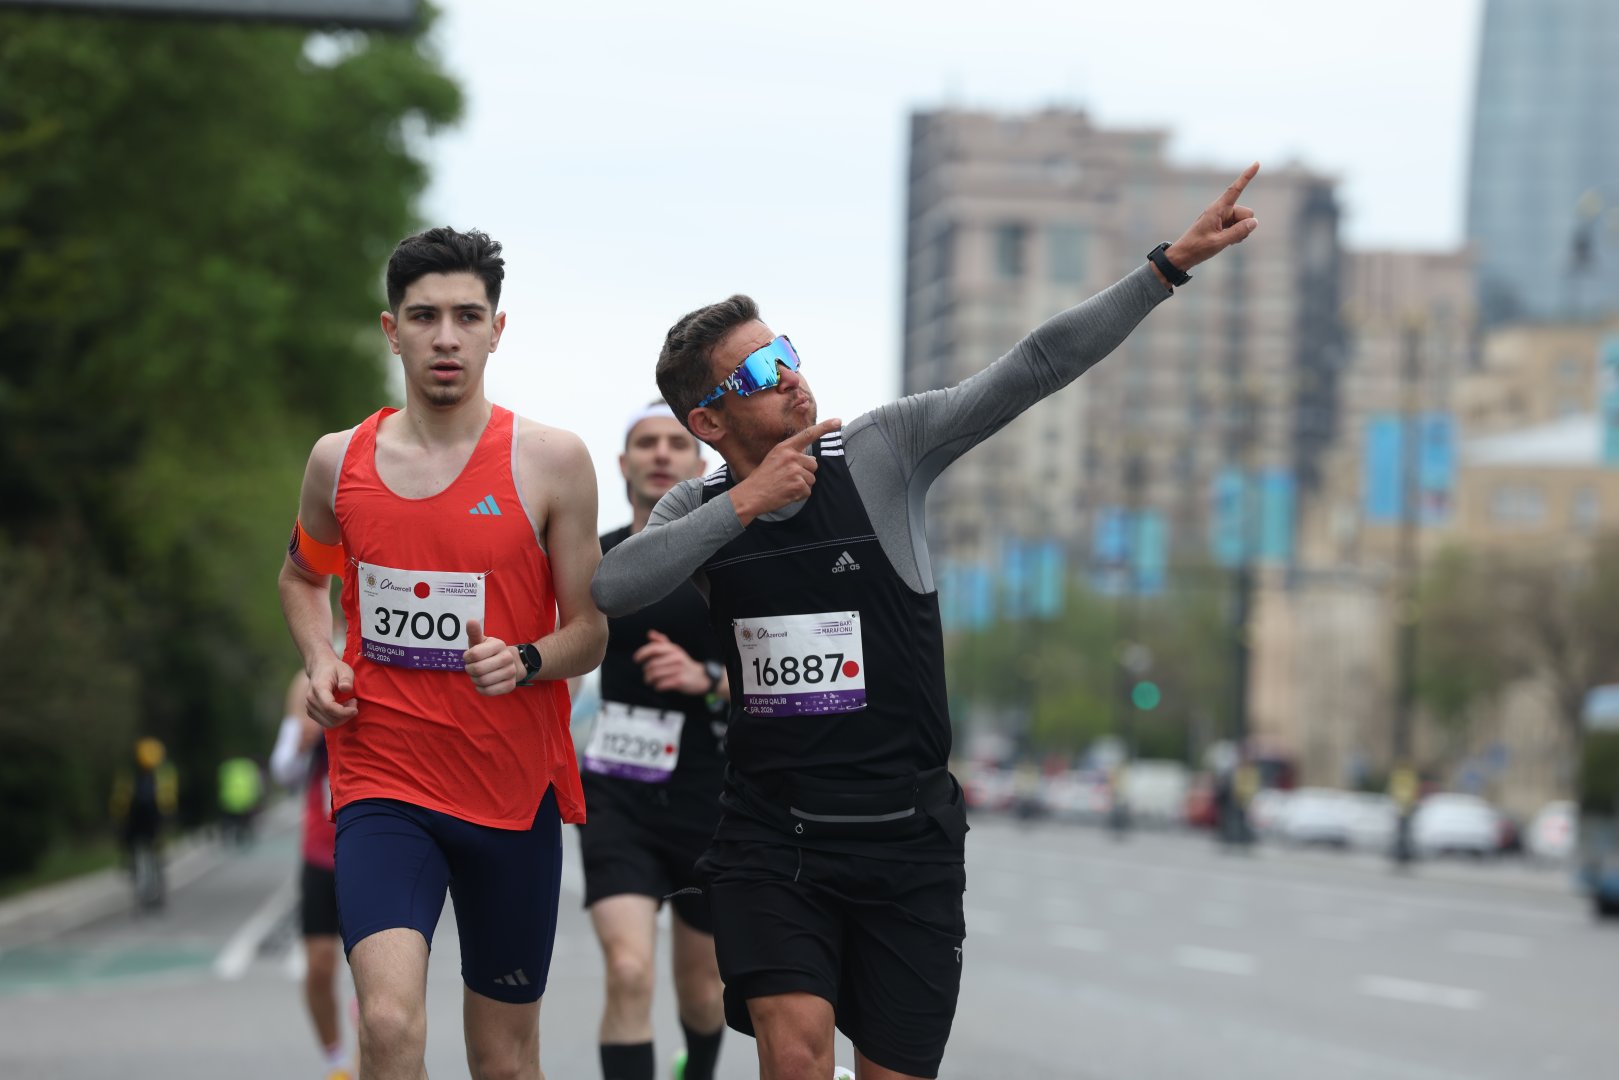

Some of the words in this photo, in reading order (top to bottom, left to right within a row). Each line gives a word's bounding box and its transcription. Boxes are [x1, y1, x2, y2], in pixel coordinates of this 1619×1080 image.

[375, 607, 461, 641] 3700
[377, 654, 391, 662] 2026
[752, 653, 845, 687] 16887
